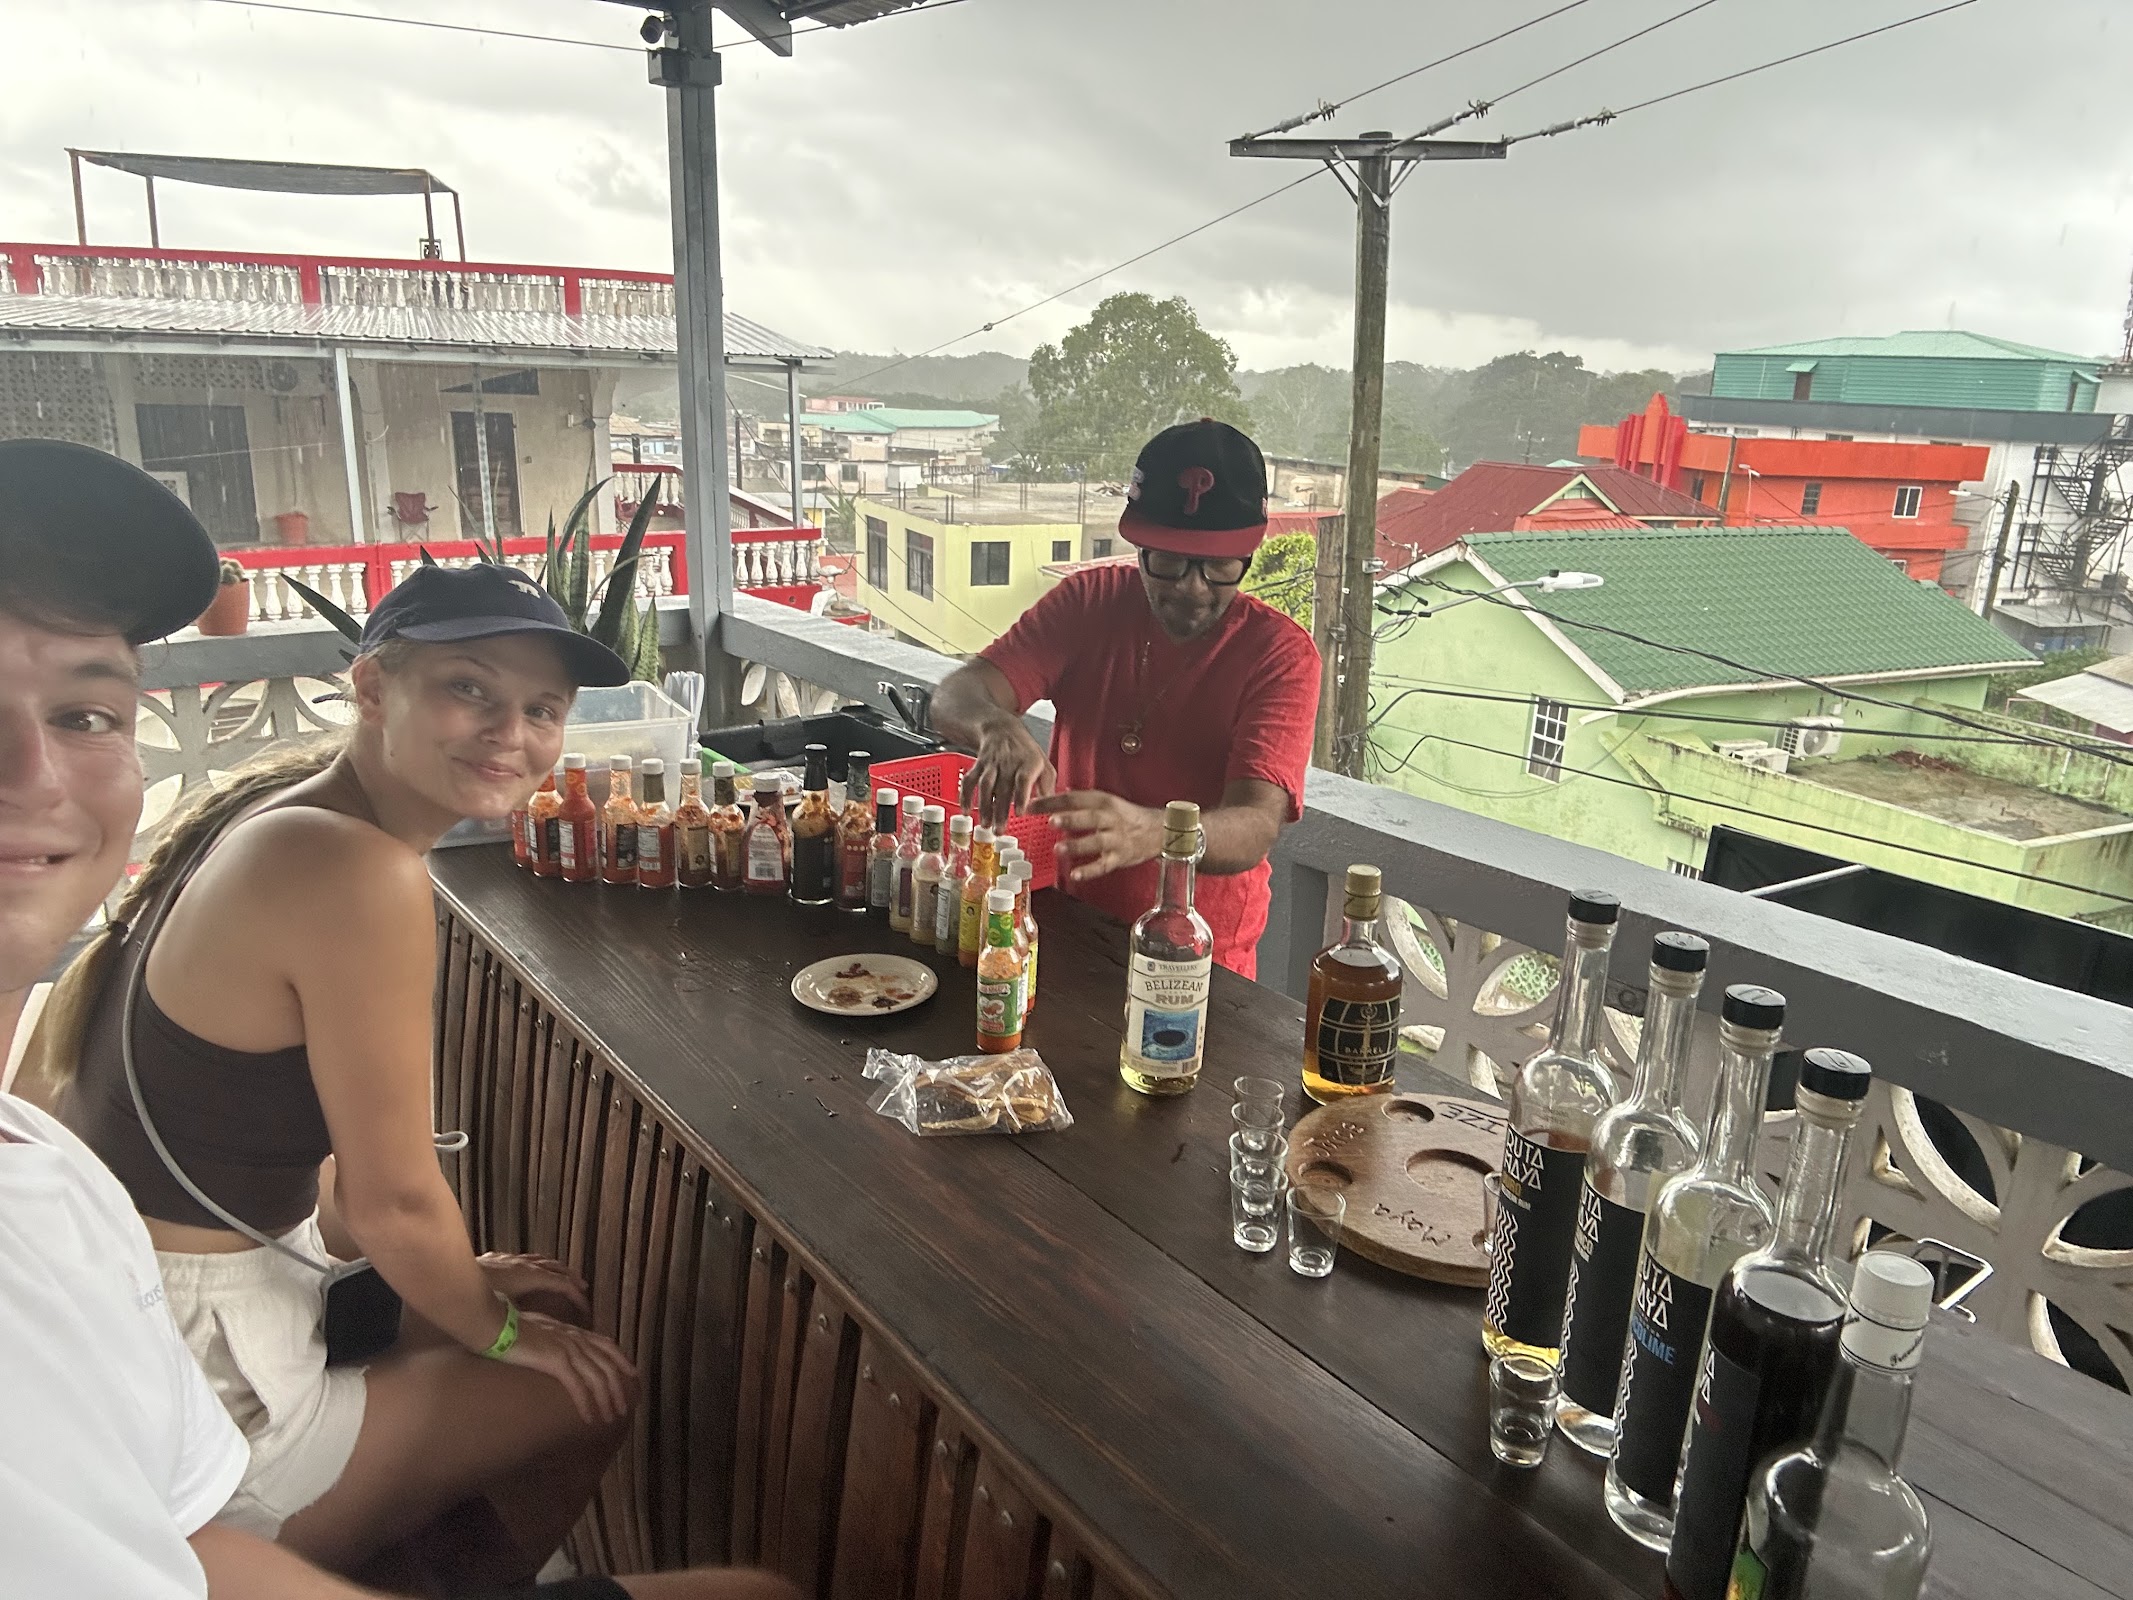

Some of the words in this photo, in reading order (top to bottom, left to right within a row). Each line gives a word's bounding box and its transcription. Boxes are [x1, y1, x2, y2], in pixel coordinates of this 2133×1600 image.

[1145, 979, 1204, 992] BELIZEAN
[1155, 993, 1195, 1006] RUM
[1506, 1128, 1545, 1171] RUTA
[1578, 1201, 1599, 1243] AYA
[1581, 1182, 1603, 1222] UTA
[1372, 1202, 1452, 1248] Maya
[1642, 1253, 1674, 1305] UTA
[1637, 1280, 1669, 1331] AYA
